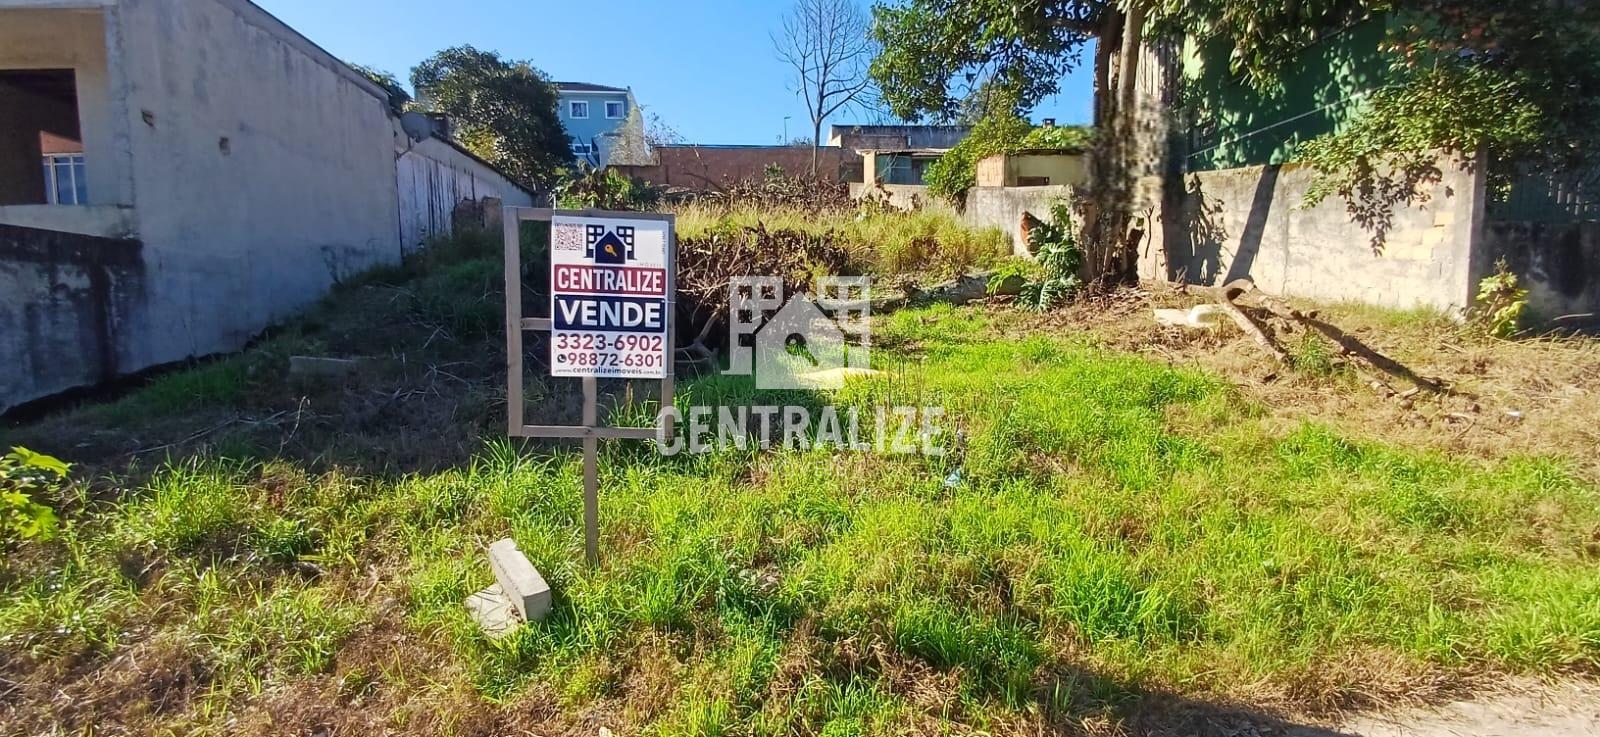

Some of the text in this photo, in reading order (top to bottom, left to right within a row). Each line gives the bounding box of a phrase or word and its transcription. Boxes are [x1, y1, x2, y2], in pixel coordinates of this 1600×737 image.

[557, 267, 663, 292] CENTRALIZE
[559, 299, 661, 328] VENDE
[557, 333, 662, 352] 3323-6902
[568, 353, 663, 367] 98872-6301
